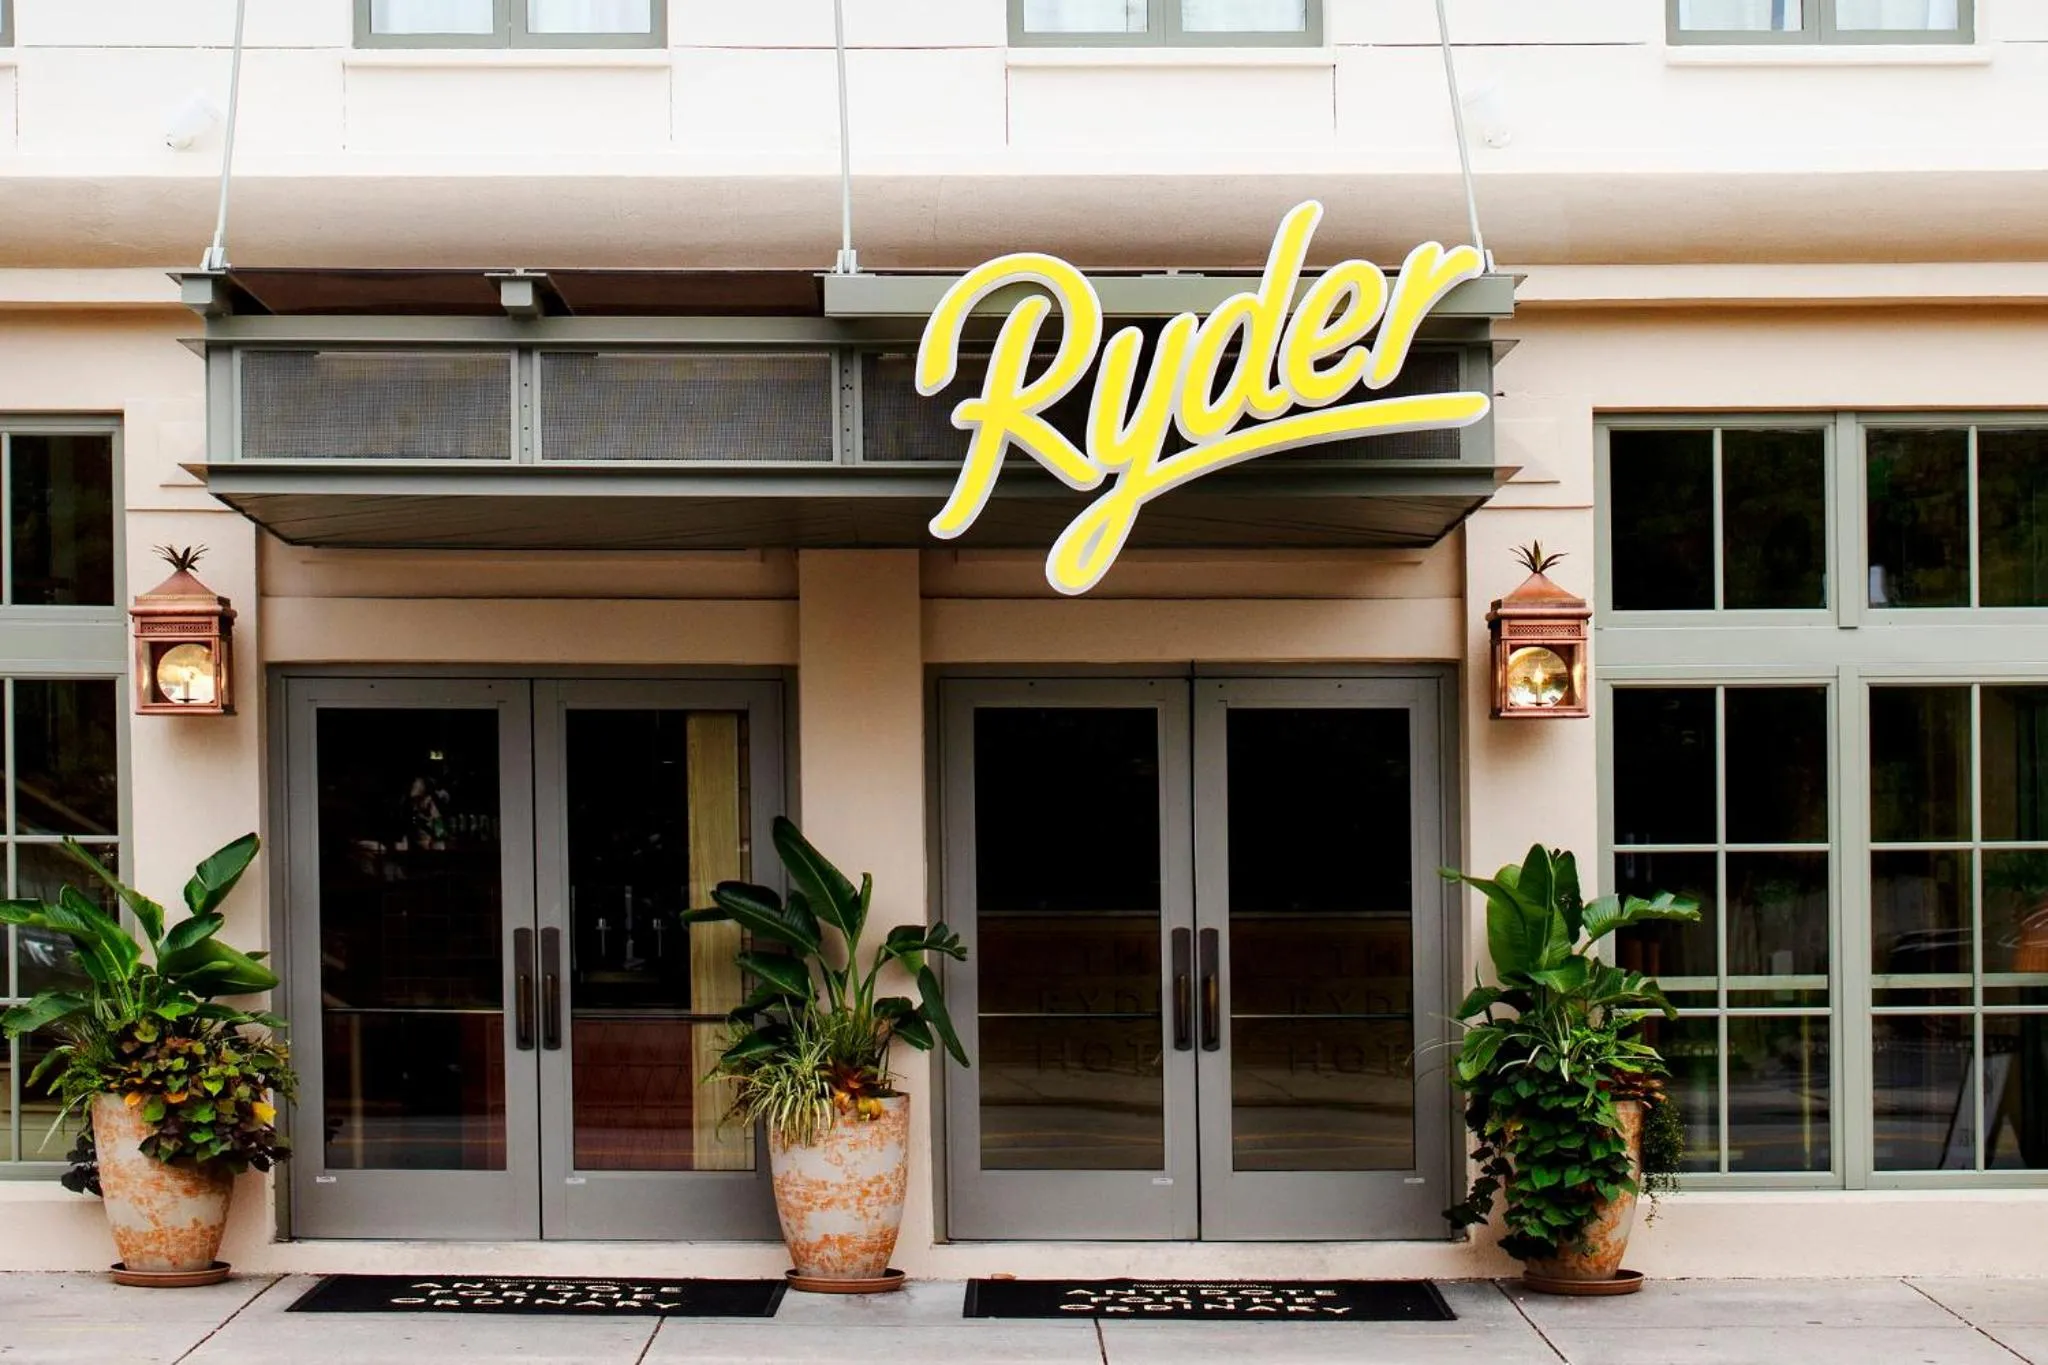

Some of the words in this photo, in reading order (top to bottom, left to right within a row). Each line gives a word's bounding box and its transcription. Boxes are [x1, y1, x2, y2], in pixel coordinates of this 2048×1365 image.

[915, 200, 1490, 595] Ryder
[411, 1283, 682, 1293] ANTIDOTE
[1066, 1289, 1337, 1297] ANTIDOTE
[429, 1290, 528, 1298] FOR
[558, 1292, 656, 1301] THE
[1217, 1296, 1317, 1304] THE
[390, 1297, 681, 1309] ORDINARY
[1059, 1303, 1351, 1314] ORDINARY
